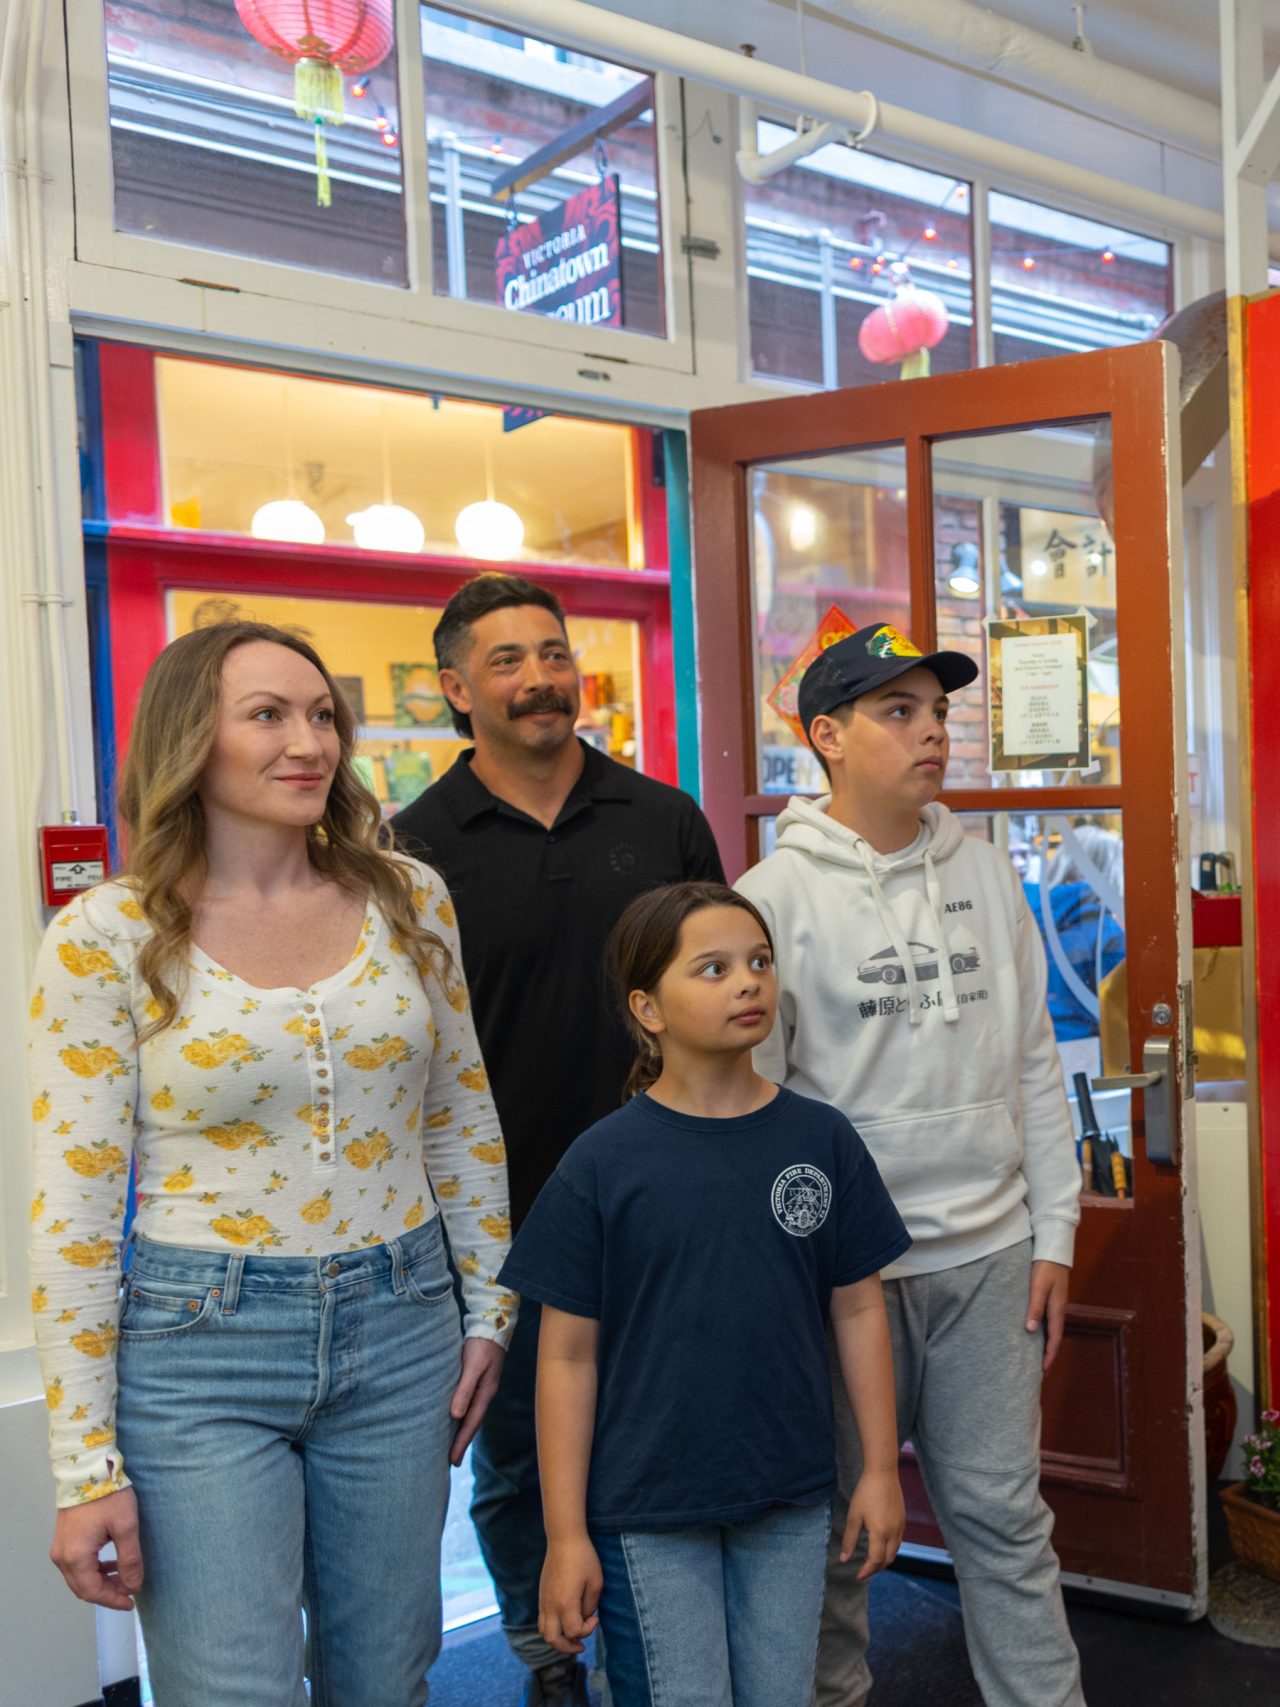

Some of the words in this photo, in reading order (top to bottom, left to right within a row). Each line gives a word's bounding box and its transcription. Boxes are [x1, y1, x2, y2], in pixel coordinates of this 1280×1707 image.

[523, 224, 587, 269] VICTORIA
[504, 243, 610, 311] Chinatown
[944, 900, 973, 914] AE86
[857, 990, 943, 1018] 藤原とふ
[775, 1179, 787, 1215] VICTORIA
[785, 1167, 802, 1180] FIRE
[804, 1167, 829, 1209] DEPARTMENT
